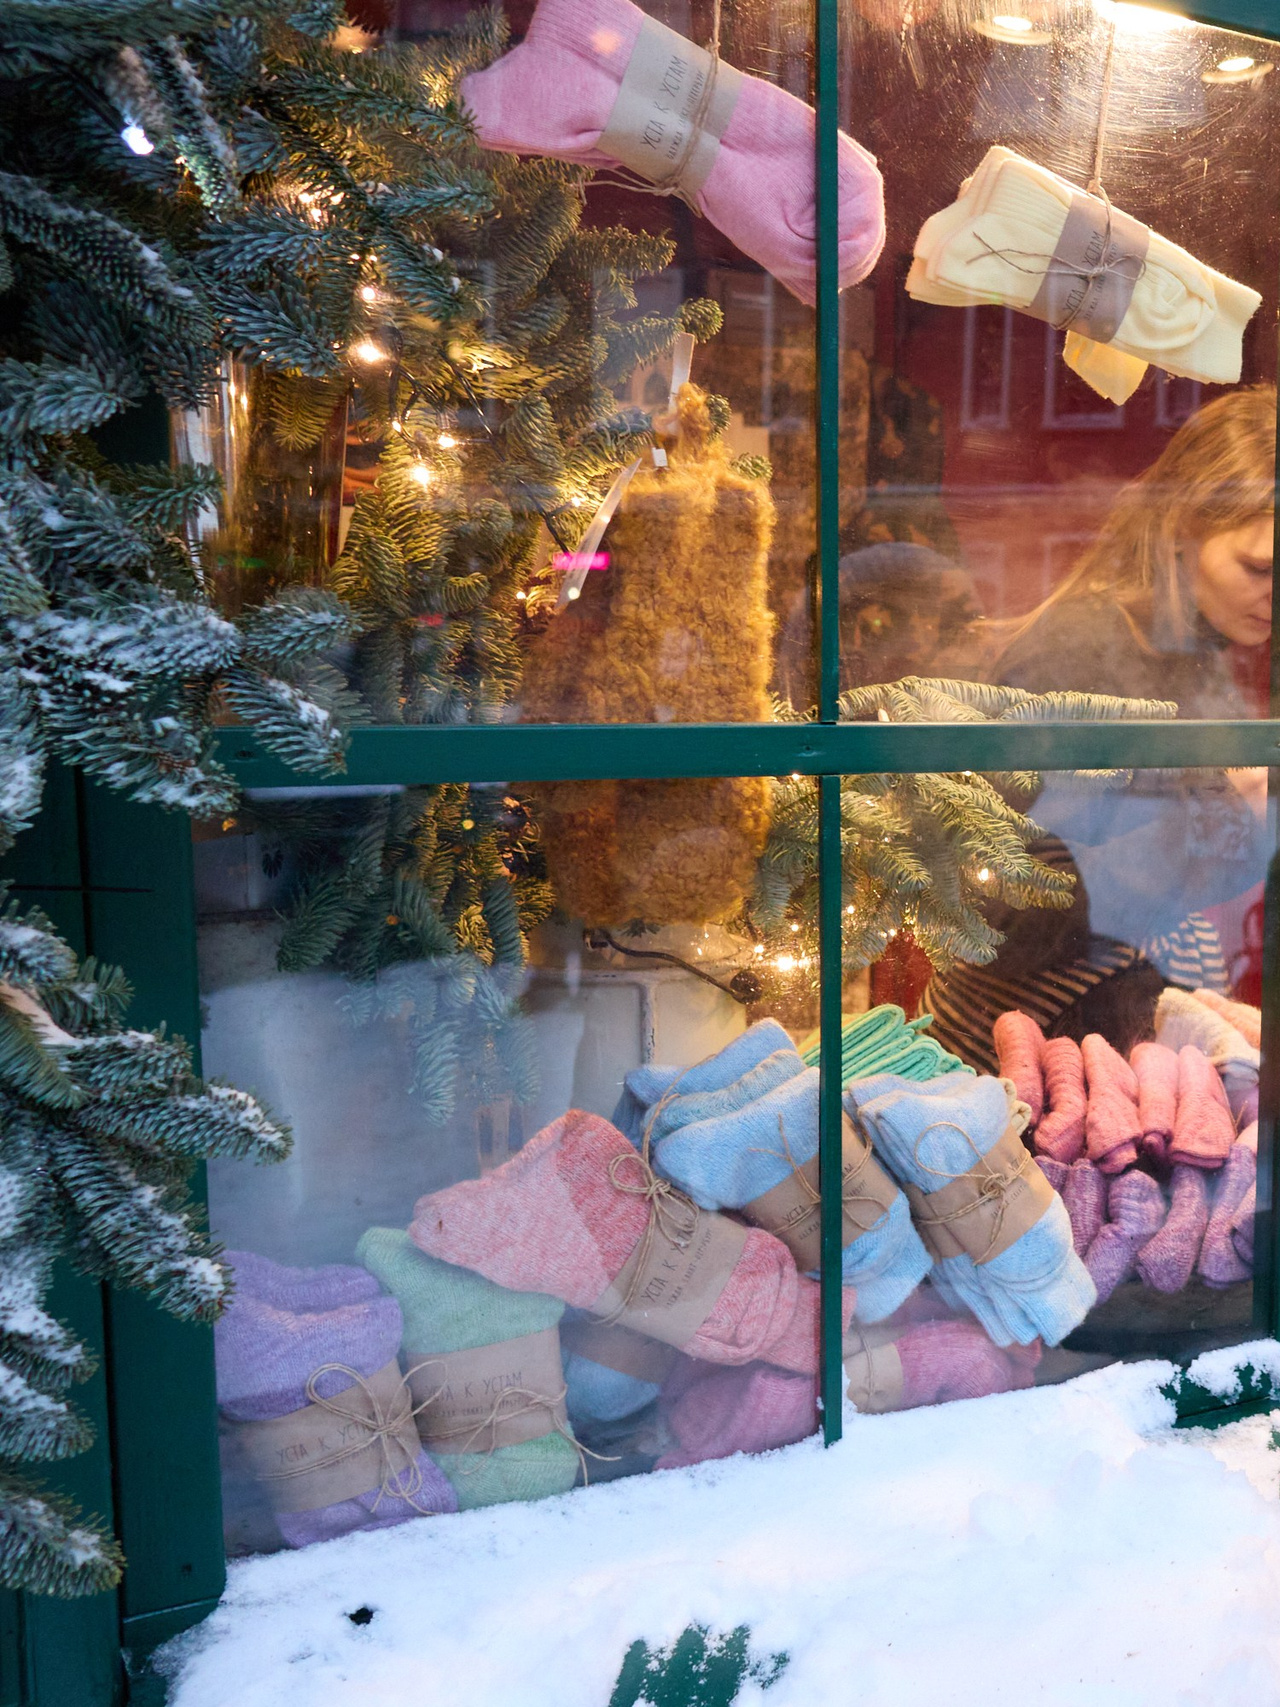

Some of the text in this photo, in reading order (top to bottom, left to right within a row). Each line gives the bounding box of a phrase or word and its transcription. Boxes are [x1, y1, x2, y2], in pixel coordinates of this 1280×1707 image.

[641, 55, 688, 150] УСТА К УСТАМ
[1082, 230, 1104, 266] УСТАМ
[641, 1277, 668, 1303] УСТА
[662, 1260, 677, 1271] К
[463, 1381, 474, 1397] К
[483, 1372, 523, 1393] УСТАМ
[276, 1444, 309, 1465] УСТА
[318, 1437, 330, 1451] К
